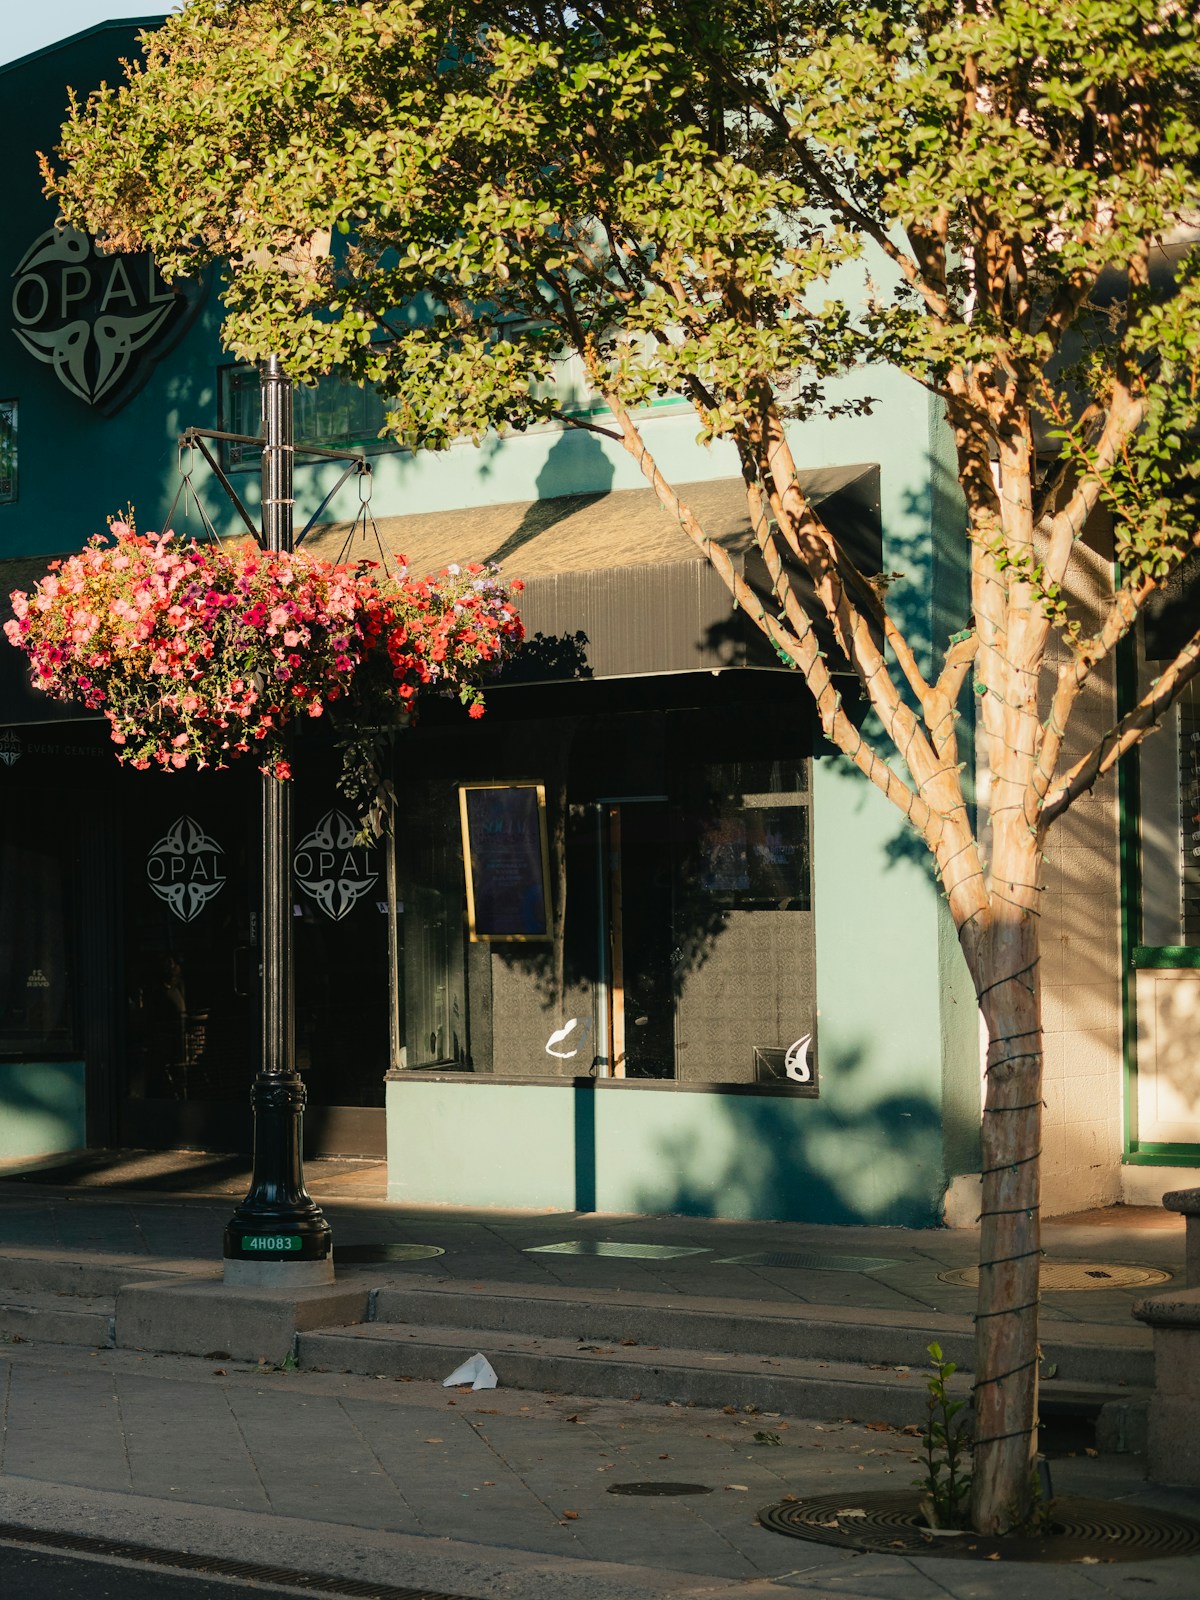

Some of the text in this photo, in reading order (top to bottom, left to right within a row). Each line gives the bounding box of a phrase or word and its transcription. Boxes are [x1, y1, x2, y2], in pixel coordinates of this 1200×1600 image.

[12, 251, 175, 325] OPAL
[27, 743, 60, 755] EVENT
[63, 744, 105, 757] CENTER
[147, 855, 227, 881] OPAL
[293, 851, 379, 878] OPAL
